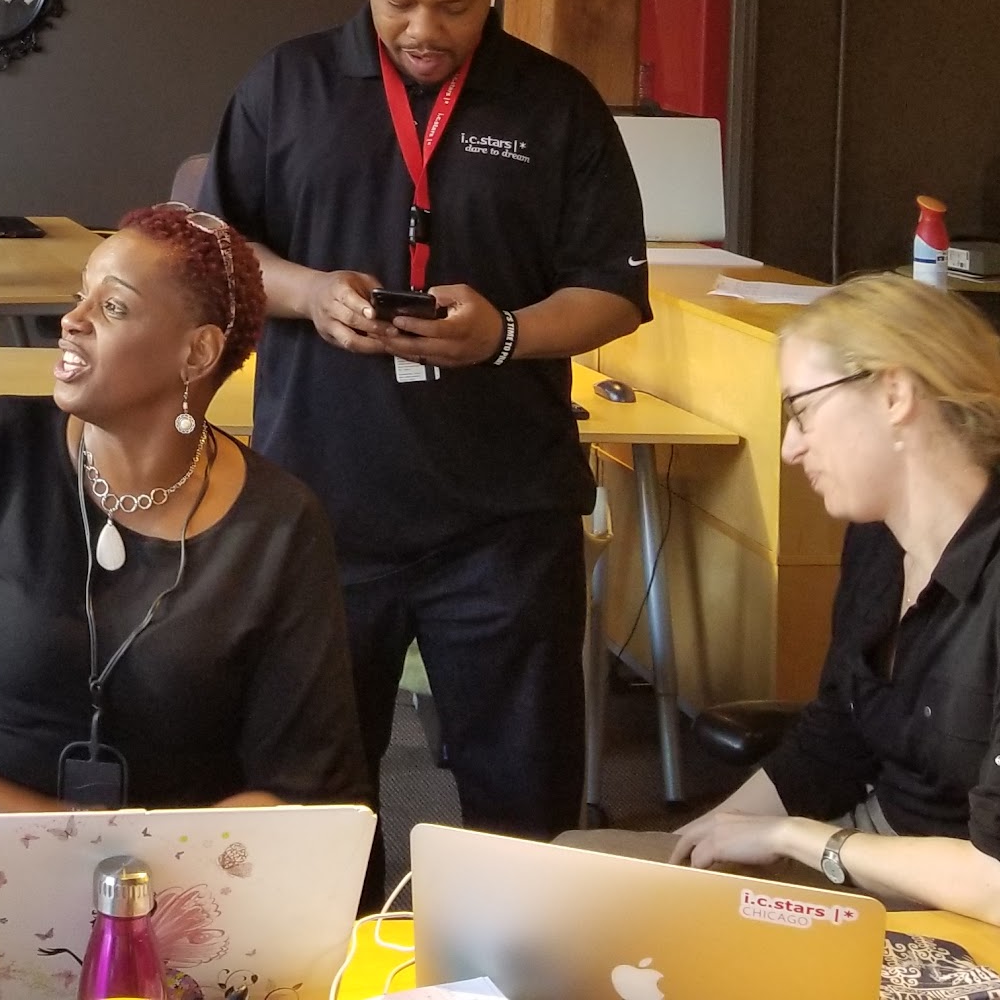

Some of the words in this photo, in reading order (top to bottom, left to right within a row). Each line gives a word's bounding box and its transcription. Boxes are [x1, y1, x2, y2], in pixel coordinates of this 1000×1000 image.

[465, 144, 488, 154] dare
[490, 147, 499, 155] to
[501, 150, 530, 163] dream
[506, 323, 514, 341] TIME
[503, 342, 512, 351] TO
[742, 907, 808, 926] CHICAGO
